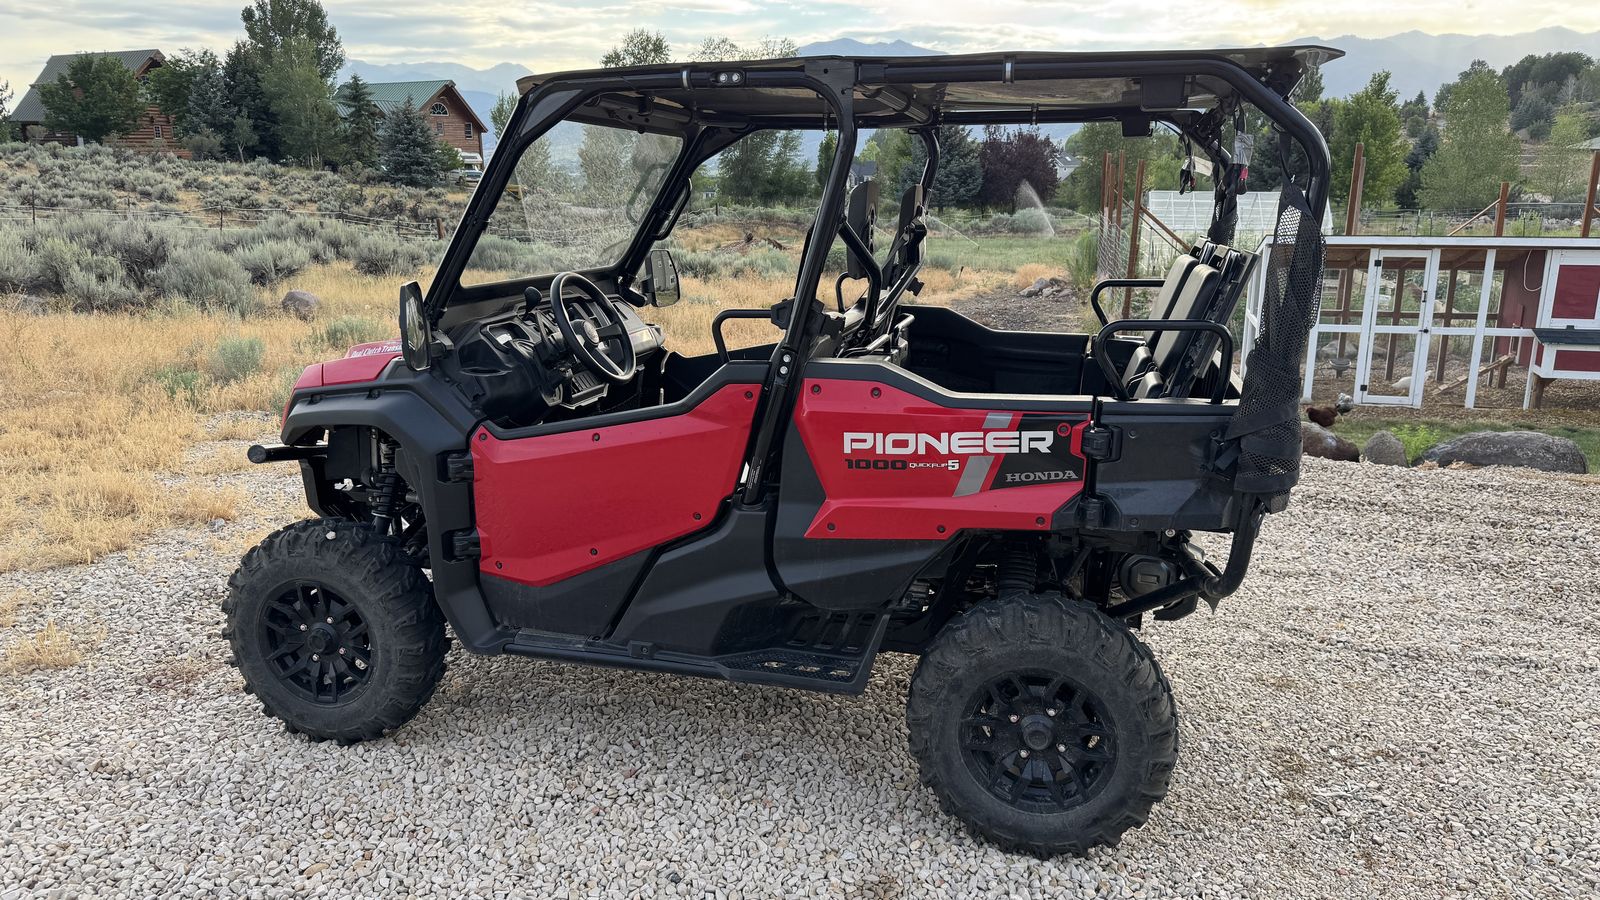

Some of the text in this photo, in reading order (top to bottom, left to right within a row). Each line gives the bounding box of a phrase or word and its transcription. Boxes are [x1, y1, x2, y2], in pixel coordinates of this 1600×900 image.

[363, 347, 382, 356] Clutch
[843, 430, 1054, 454] PIONEER
[845, 458, 908, 471] 1000
[1005, 470, 1078, 482] HONDA
